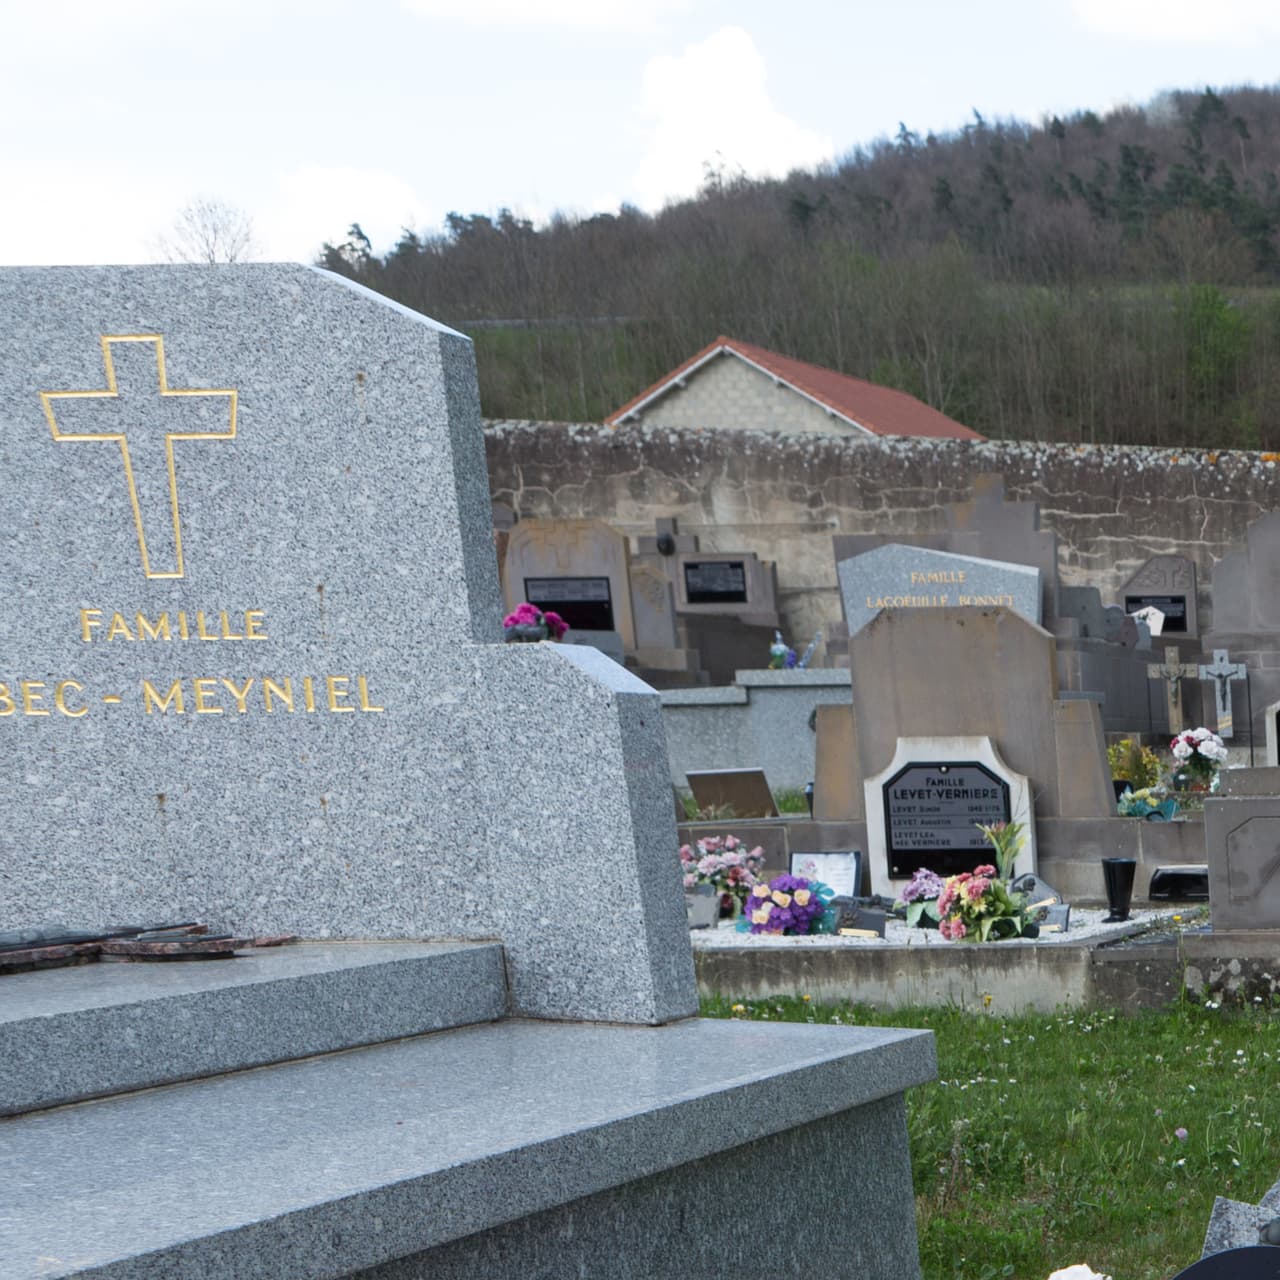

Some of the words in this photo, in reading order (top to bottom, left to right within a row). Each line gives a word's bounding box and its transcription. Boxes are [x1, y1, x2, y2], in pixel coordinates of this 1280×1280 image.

[911, 570, 968, 584] FAMILLE
[80, 609, 269, 641] FAMILLE
[143, 675, 384, 714] MEYNIEL
[925, 777, 965, 787] FAMILLE
